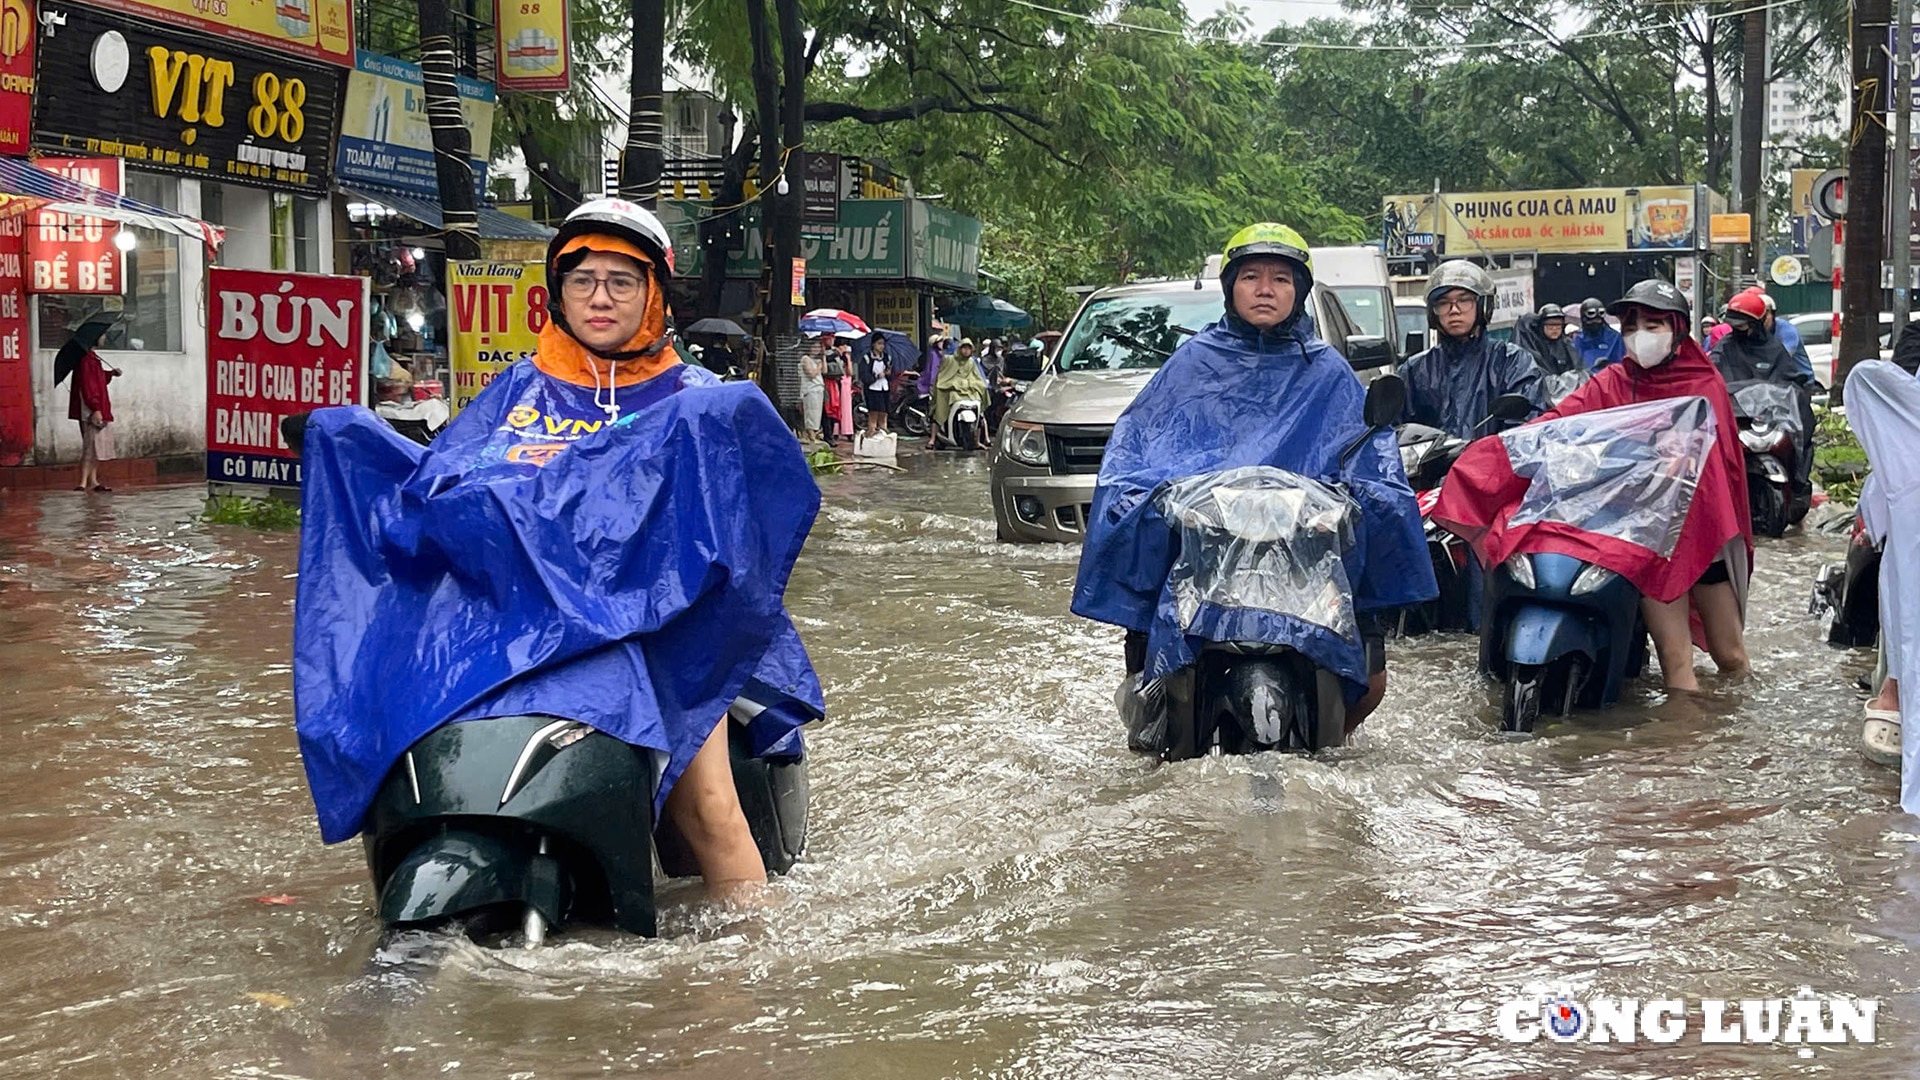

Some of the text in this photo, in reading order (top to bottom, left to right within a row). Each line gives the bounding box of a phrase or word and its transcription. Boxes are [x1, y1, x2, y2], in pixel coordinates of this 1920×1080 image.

[146, 46, 306, 146] VỊT 88
[373, 153, 396, 171] ANH
[1454, 195, 1617, 223] PHỤNG CUA CÀ MAU
[1511, 226, 1532, 239] CUA
[828, 210, 893, 260] HUẾ
[218, 280, 355, 349] BÚN
[453, 283, 550, 345] VỊT 8
[216, 353, 257, 399] RIÊU
[262, 363, 297, 402] CUA
[215, 402, 273, 448] BÁNH
[223, 455, 246, 477] CÓ
[251, 458, 290, 482] MÁY
